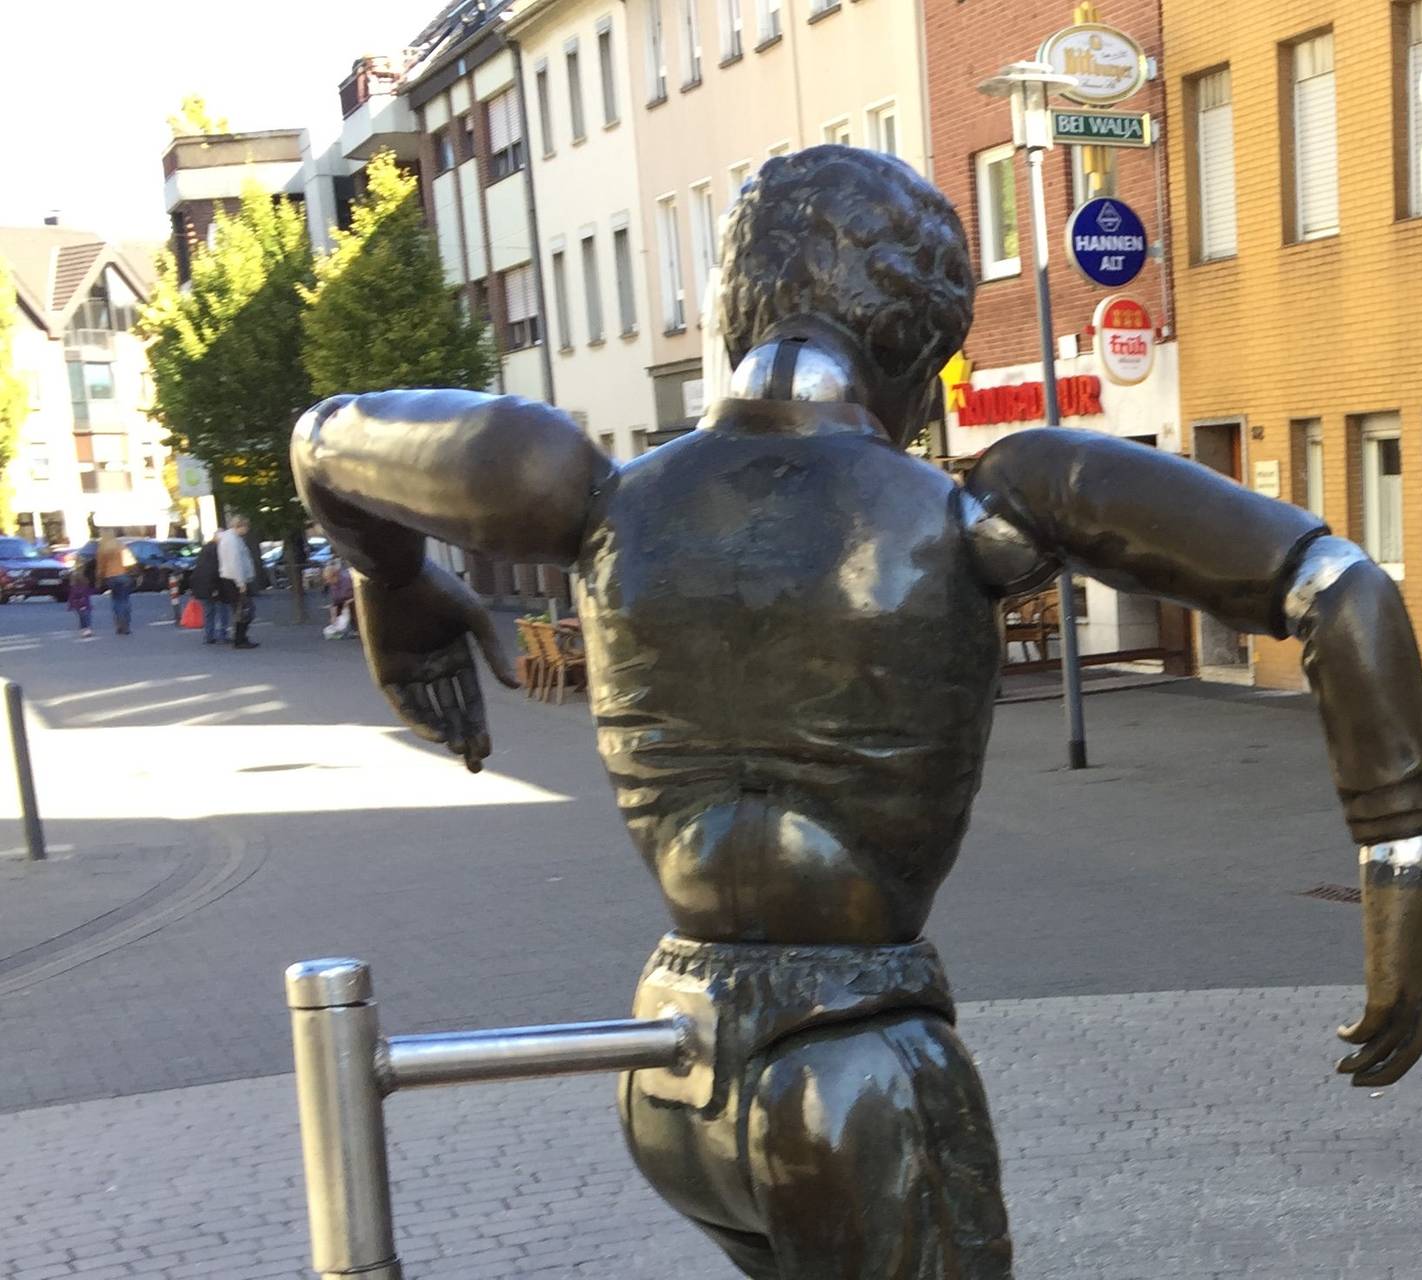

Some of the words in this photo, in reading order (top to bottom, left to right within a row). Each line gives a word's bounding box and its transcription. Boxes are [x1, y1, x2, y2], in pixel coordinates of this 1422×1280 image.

[1057, 115, 1085, 133] BEI
[1088, 116, 1142, 138] WALJA
[1075, 235, 1144, 252] HANNEN
[1099, 256, 1126, 271] ALT
